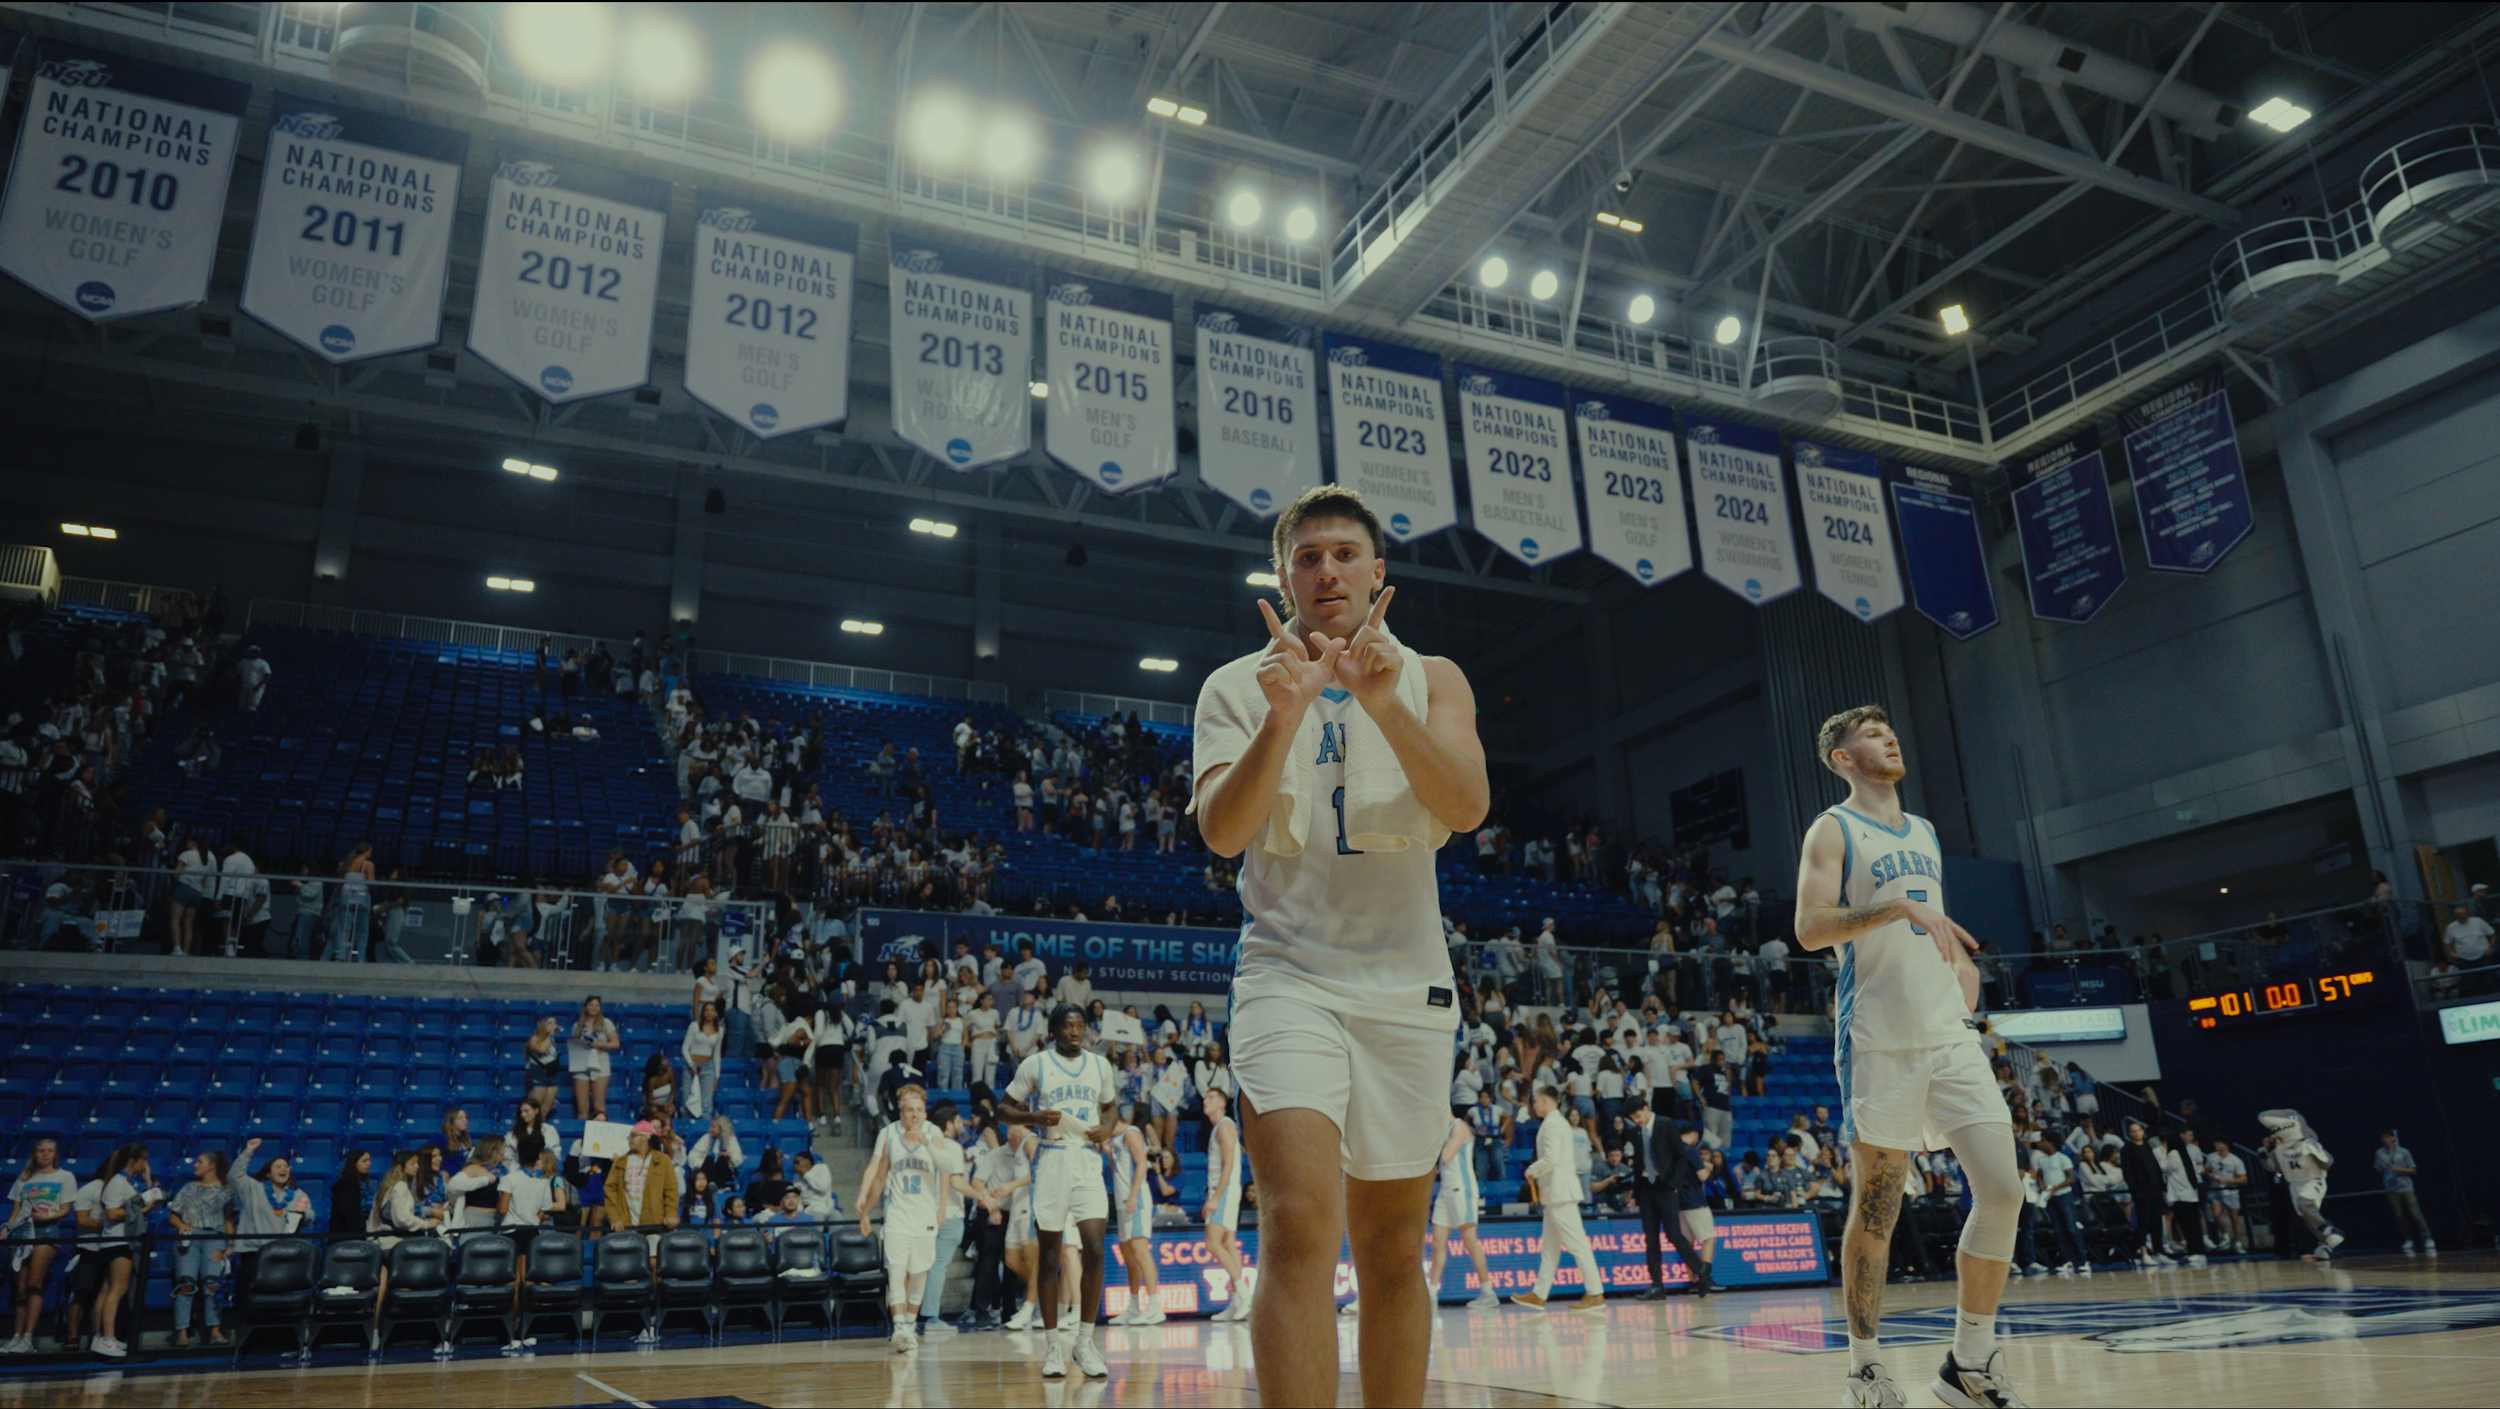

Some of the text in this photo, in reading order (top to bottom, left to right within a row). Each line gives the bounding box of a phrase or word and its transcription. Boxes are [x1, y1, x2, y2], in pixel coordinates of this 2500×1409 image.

[41, 61, 113, 88] NSU
[47, 91, 213, 146] NATIONAL
[276, 114, 343, 139] NSU
[43, 116, 210, 166] CHAMPIONS
[56, 154, 178, 212] 2010
[285, 144, 436, 194] NATIONAL
[497, 162, 558, 188] NSU
[282, 168, 434, 214] CHAMPIONS
[44, 207, 173, 250] WOMEN'S
[301, 203, 406, 258] 2011
[508, 192, 646, 241] NATIONAL
[700, 209, 756, 233] NSU
[505, 214, 644, 260] CHAMPIONS
[68, 237, 140, 268] GOLF
[712, 236, 838, 281] NATIONAL
[893, 252, 943, 273] NSU
[288, 255, 404, 295] WOMEN'S
[517, 249, 623, 302] 2012
[710, 258, 837, 300] CHAMPIONS
[311, 283, 375, 311] GOLF
[905, 279, 1020, 318] NATIONAL
[1050, 286, 1093, 306] NSU
[513, 298, 619, 337] WOMEN'S
[725, 293, 818, 341] 2012
[904, 300, 1020, 337] CHAMPIONS
[1060, 311, 1161, 348] NATIONAL
[534, 326, 594, 354] GOLF
[920, 332, 1005, 376] 2013
[1059, 331, 1161, 365] CHAMPIONS
[737, 342, 800, 372] MEN'S
[1209, 338, 1303, 373] NATIONAL
[742, 365, 794, 391] GOLF
[1074, 361, 1149, 403] 2015
[1209, 357, 1304, 389] CHAMPIONS
[1341, 372, 1433, 405] NATIONAL
[2140, 381, 2199, 417] REGIONAL
[1086, 407, 1137, 431] MEN'S
[1223, 386, 1294, 425] 2016
[1342, 392, 1435, 420] CHAMPIONS
[1471, 401, 1557, 433] NATIONAL
[1090, 428, 1133, 450] GOLF
[1221, 426, 1297, 454] BASEBALL
[1357, 420, 1427, 456] 2023
[1472, 419, 1558, 449] CHAMPIONS
[1587, 425, 1667, 456] NATIONAL
[1487, 447, 1552, 483] 2023
[1588, 444, 1670, 471] CHAMPIONS
[1699, 450, 1774, 479] NATIONAL
[2027, 441, 2078, 475] REGIONAL
[1361, 460, 1430, 486] WOMEN'S
[1604, 470, 1664, 504] 2023
[1700, 467, 1777, 493] CHAMPIONS
[1806, 473, 1876, 501] NATIONAL
[1358, 478, 1436, 507] SWIMMING
[1502, 488, 1545, 509] MEN'S
[1809, 489, 1880, 515] CHAMPIONS
[1483, 504, 1567, 532] BASKETBALL
[1619, 511, 1659, 531] MEN'S
[1714, 493, 1770, 526] 2024
[1625, 530, 1657, 548] GOLF
[1718, 530, 1776, 554] WOMEN'S
[1823, 515, 1875, 546] 2024
[1716, 547, 1783, 572] SWIMMING
[1828, 550, 1883, 572] WOMEN'S
[990, 930, 1076, 957] HOME
[1084, 936, 1124, 959] OF
[1131, 938, 1184, 963] THE
[1099, 966, 1164, 980] STUDENT
[1171, 970, 1231, 983] SECTION
[2265, 983, 2301, 1010] 0.0
[2319, 975, 2351, 1001] 57
[2023, 1013, 2116, 1027] COURTYARD
[1049, 1084, 1097, 1107] SHARKS
[903, 1175, 921, 1194] 12
[1724, 1235, 1812, 1249] A BOGO PIZZA CARD
[1731, 1224, 1774, 1236] STUDENTS
[1776, 1223, 1810, 1234] RECEIVE
[1742, 1251, 1758, 1261] ON
[1758, 1250, 1775, 1260] THE
[1755, 1260, 1817, 1273] REWARDS APP
[1465, 1271, 1514, 1289] MN'S
